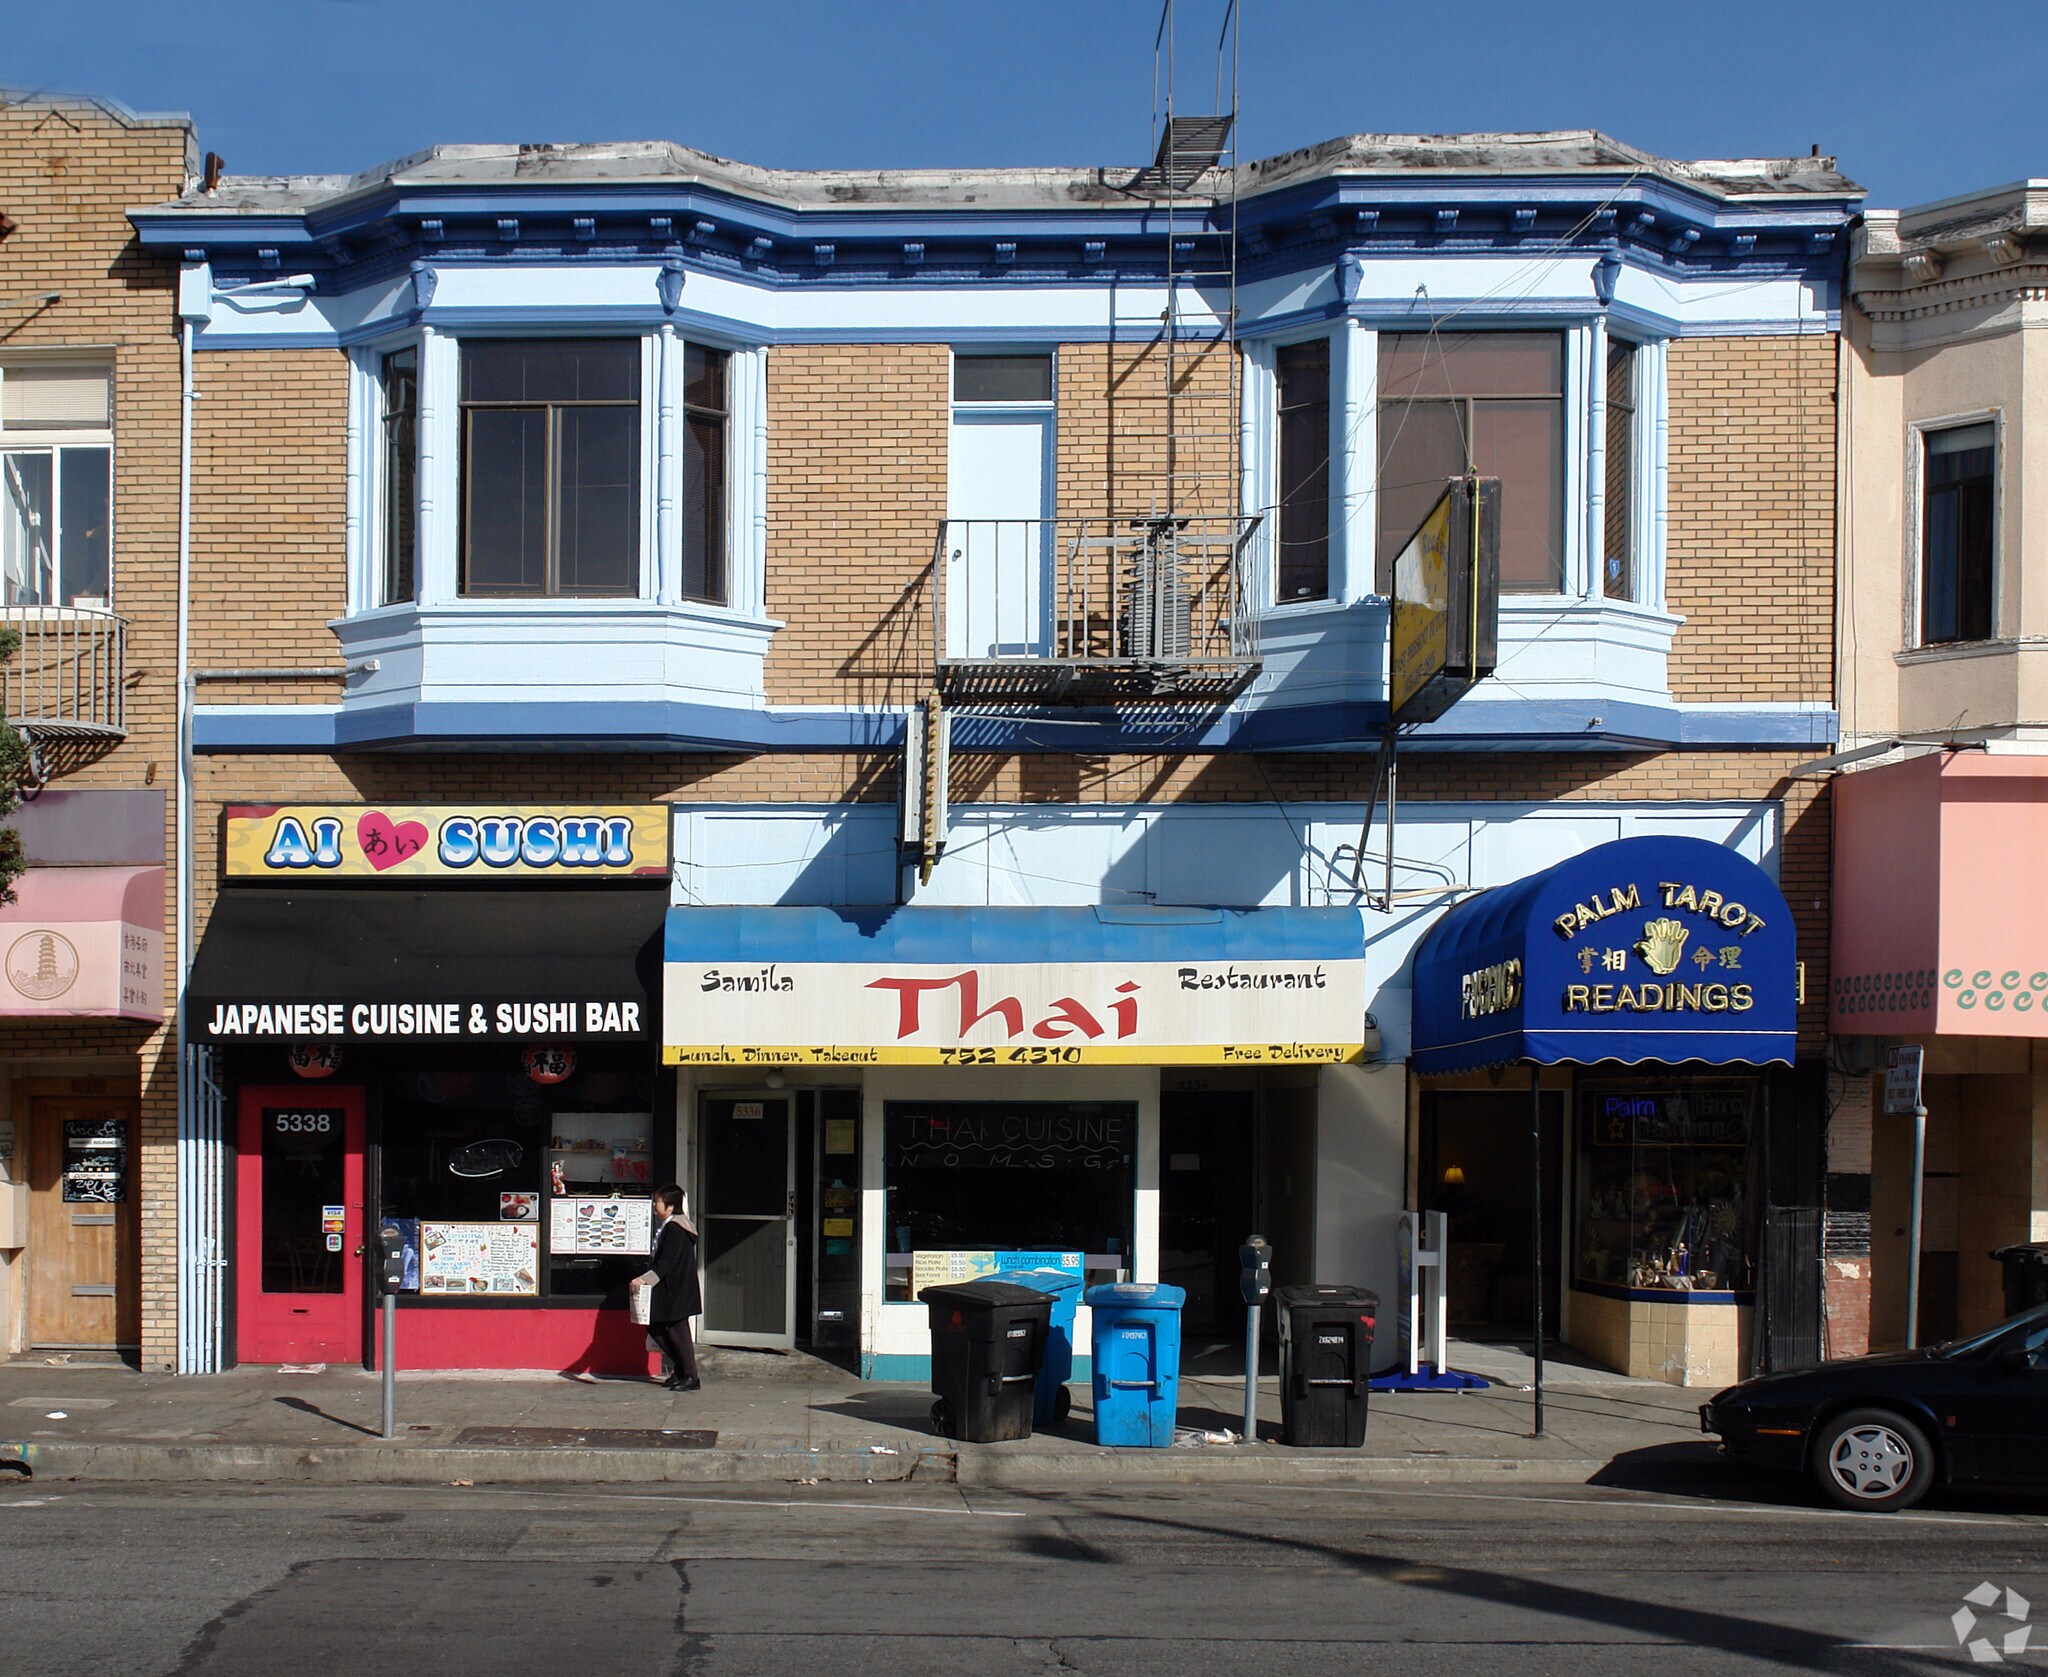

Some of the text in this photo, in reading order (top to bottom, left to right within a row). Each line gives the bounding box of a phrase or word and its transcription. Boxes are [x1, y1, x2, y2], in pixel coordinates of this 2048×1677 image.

[264, 815, 343, 868] AI
[364, 826, 421, 857] あい
[439, 814, 635, 868] SUSHI
[1553, 880, 1767, 941] PALM TAROT
[1576, 945, 1742, 974] 掌相 命理
[701, 964, 794, 992] Samila
[1178, 965, 1327, 991] Restaurant
[863, 969, 1141, 1040] Thai
[1565, 983, 1754, 1012] READINGS
[208, 1001, 641, 1036] JAPANESE CUISINE & SUSHI BAR
[678, 1047, 878, 1063] Lunch, Dinner, Takeout
[940, 1047, 1083, 1065] 752 4310
[1223, 1042, 1346, 1063] Free Delivery
[736, 1105, 762, 1117] 5336
[1605, 1096, 1657, 1118] Palm
[276, 1114, 331, 1133] 5338
[902, 1115, 1123, 1143] THAI CUISINE
[1001, 1255, 1079, 1266] Lunch combination $5.95
